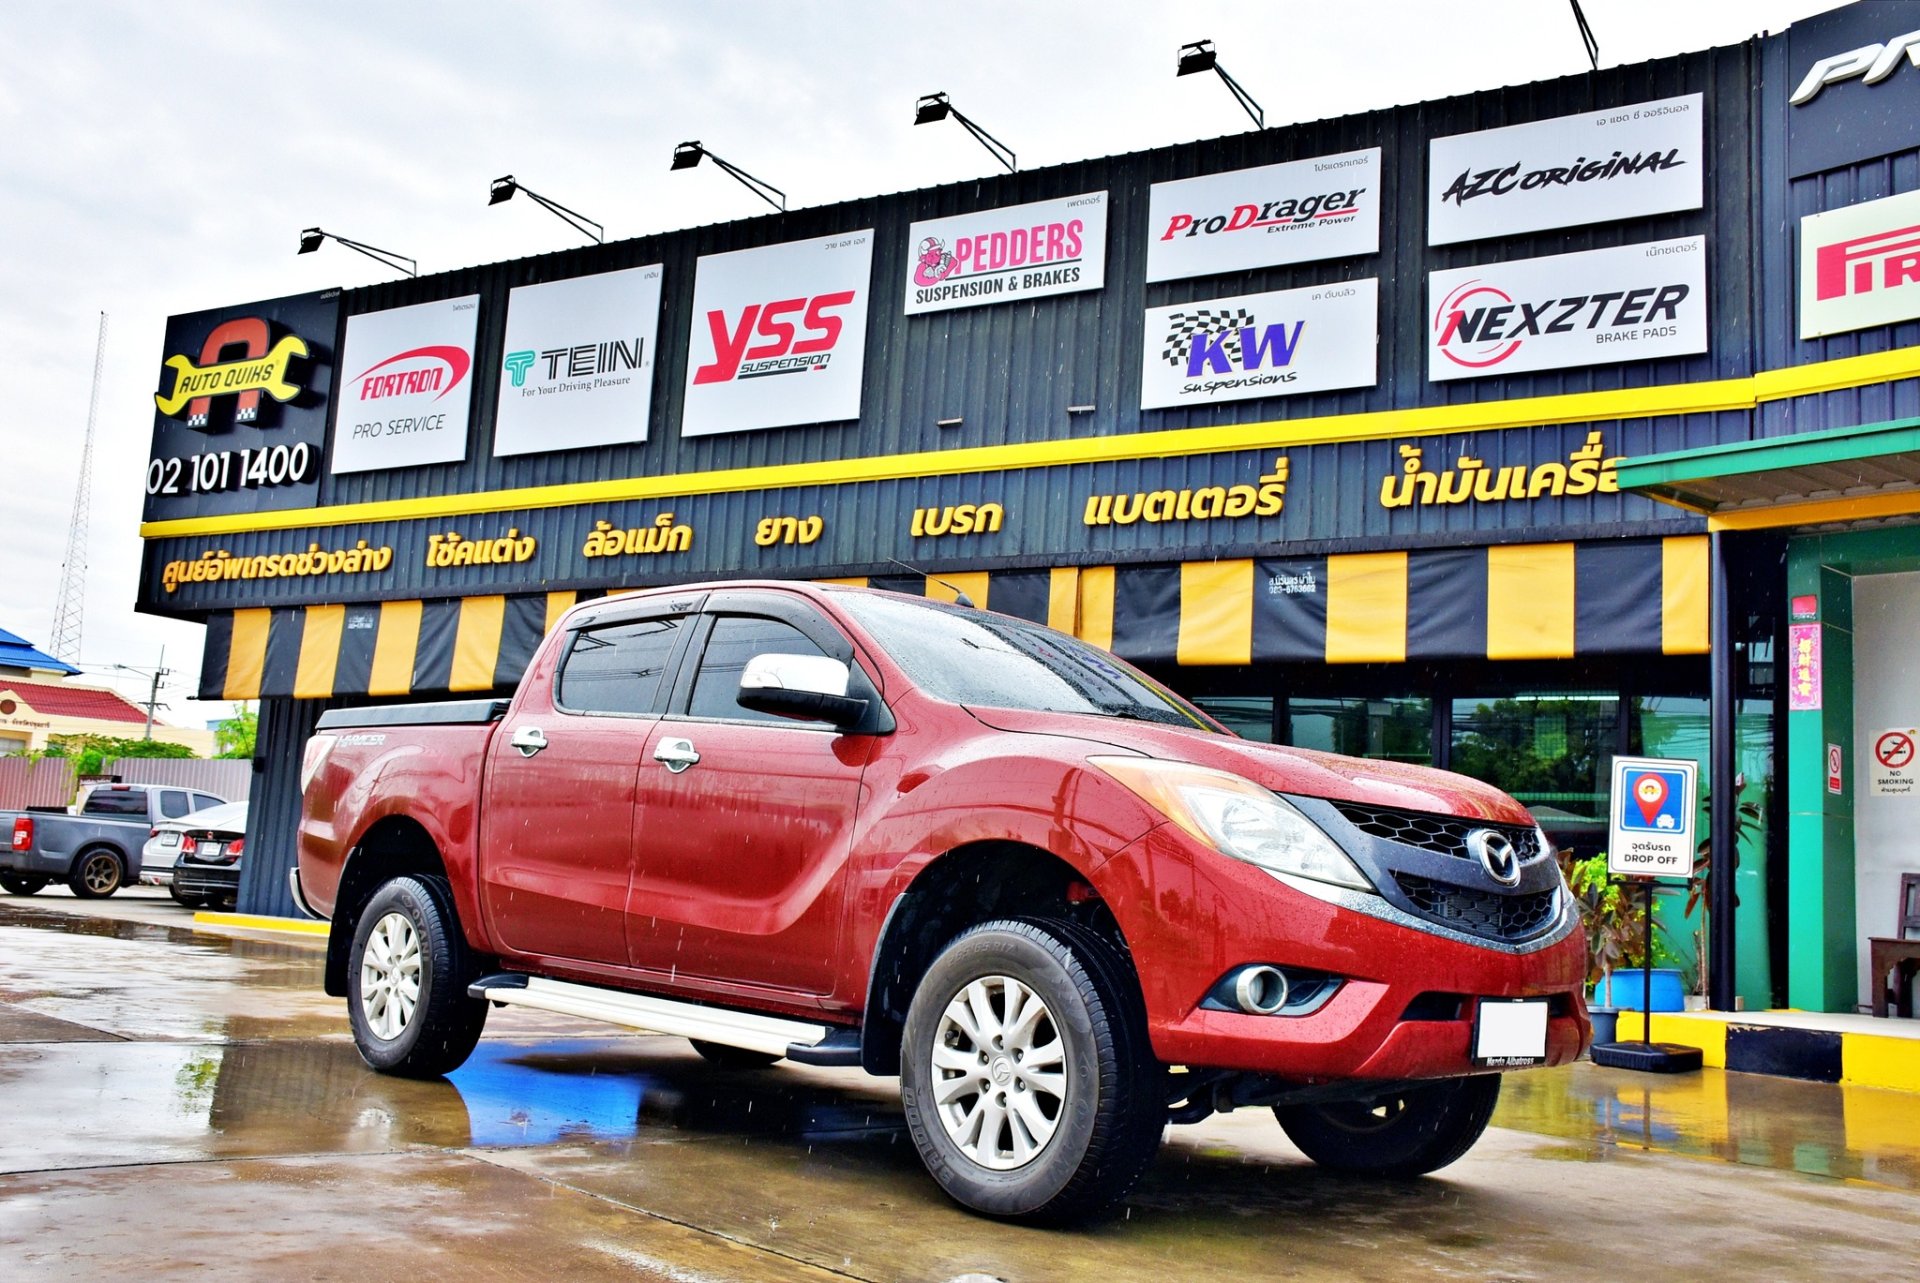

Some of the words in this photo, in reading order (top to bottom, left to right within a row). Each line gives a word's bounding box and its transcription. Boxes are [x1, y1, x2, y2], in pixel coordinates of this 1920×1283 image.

[1442, 161, 1521, 207] AZC
[1160, 188, 1366, 241] ProDrager
[1267, 222, 1315, 234] Extreme
[1319, 215, 1356, 227] Power
[953, 219, 1083, 275] PEDDERS
[916, 278, 1003, 304] SUSPENSION
[1008, 276, 1018, 291] &
[1023, 267, 1080, 289] BRAKES
[1437, 284, 1689, 346] NEXZTER
[693, 290, 855, 385] YSS
[1186, 320, 1306, 377] KW
[1596, 330, 1638, 344] BRAKE
[1643, 326, 1677, 339] PADS
[541, 337, 644, 380] TEIN
[740, 354, 831, 374] SUSPENSION
[179, 372, 221, 394] AUTO
[360, 367, 443, 401] FORTRON
[522, 388, 535, 397] For
[538, 385, 556, 395] Your
[559, 381, 592, 393] Driving
[594, 376, 631, 388] Pleasure
[1179, 372, 1298, 395] suspensions
[353, 422, 382, 439] PRO
[387, 414, 446, 436] SERVICE
[146, 457, 182, 495] 02
[191, 452, 231, 491] 101
[240, 442, 309, 487] 1400
[1083, 456, 1290, 526] แบตเตอรี่
[583, 513, 693, 557] ล้อแม็ก
[755, 515, 824, 546] ยาง
[911, 503, 1004, 537] เบรก
[426, 529, 536, 568] โช้คแต่ง
[162, 543, 392, 593] ศูนย์อัพเกรดช่วงล่าง
[1877, 778, 1914, 786] SMOKING
[1624, 854, 1654, 863] DROP
[1657, 856, 1678, 864] OFF
